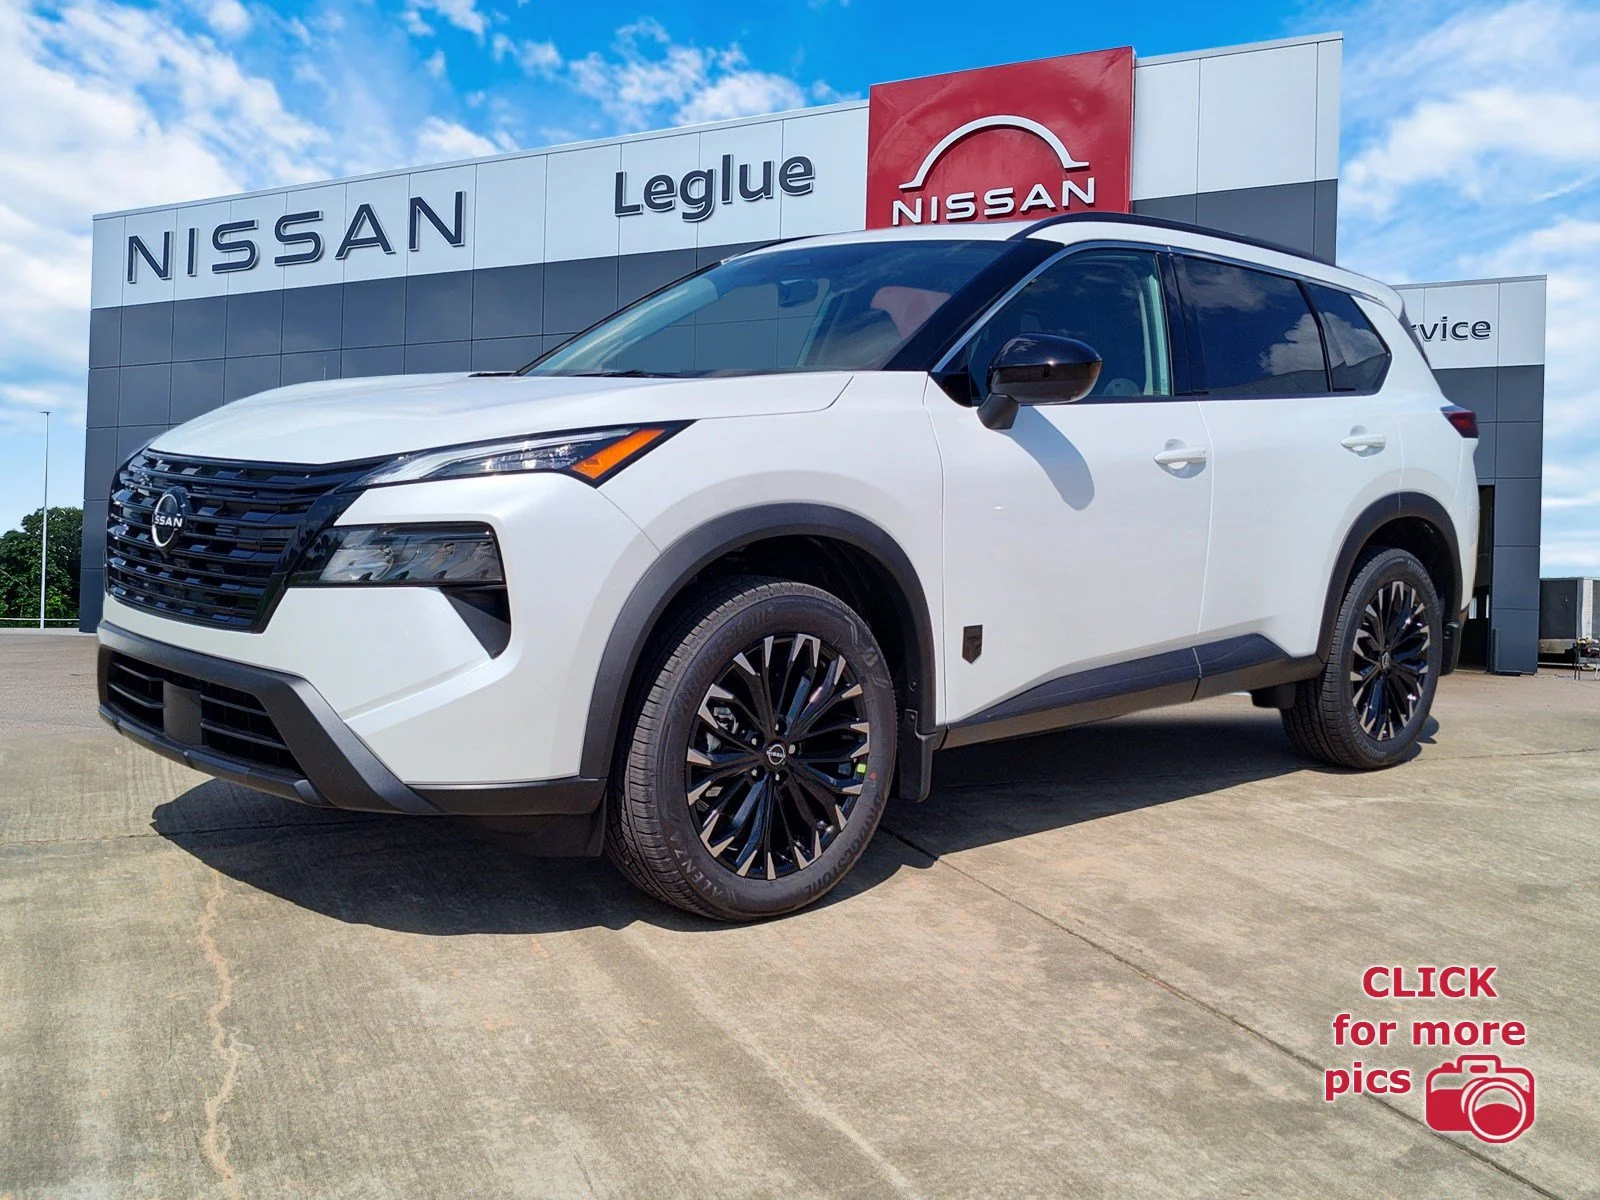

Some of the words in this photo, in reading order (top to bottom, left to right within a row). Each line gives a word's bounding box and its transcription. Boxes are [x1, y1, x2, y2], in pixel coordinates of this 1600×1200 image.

[613, 154, 816, 223] Leglue
[892, 176, 1096, 226] NISSAN
[127, 190, 466, 284] NISSAN
[1410, 315, 1492, 342] vice
[153, 514, 184, 528] SSAN
[669, 830, 724, 899] ALENZA
